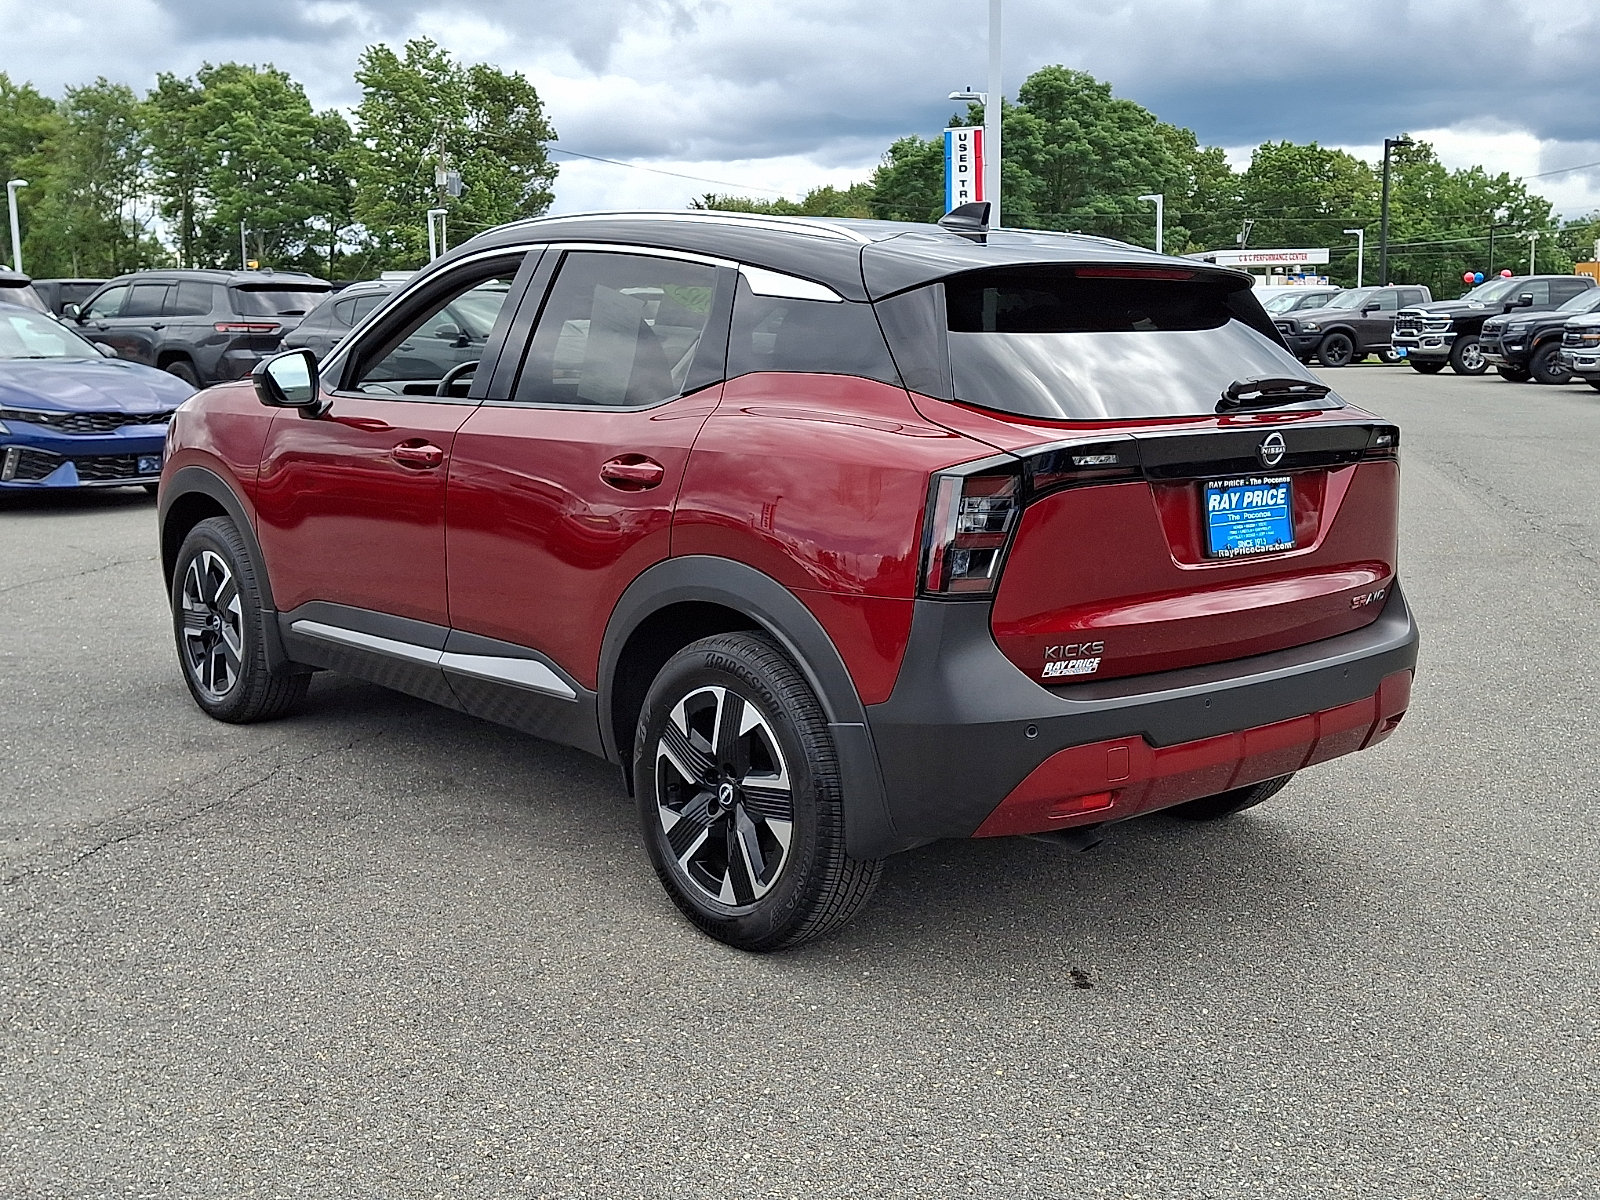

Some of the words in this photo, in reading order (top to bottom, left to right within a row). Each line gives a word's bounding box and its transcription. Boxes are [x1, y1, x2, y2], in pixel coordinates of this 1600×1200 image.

[958, 133, 968, 173] USED
[1253, 253, 1289, 261] PERFORMANCE
[1289, 252, 1308, 261] CENTER
[1261, 446, 1286, 455] NISSAN
[1208, 481, 1223, 489] RAY
[1223, 479, 1245, 488] PRICE
[1249, 478, 1262, 486] The
[1208, 492, 1241, 512] RAY
[1242, 488, 1287, 508] PRICE
[1218, 543, 1293, 558] RayPriceCars.com
[1044, 640, 1105, 660] KICKS
[1045, 660, 1069, 672] RAY
[1067, 657, 1102, 669] PRICE
[704, 653, 787, 720] BRIDGESTONE
